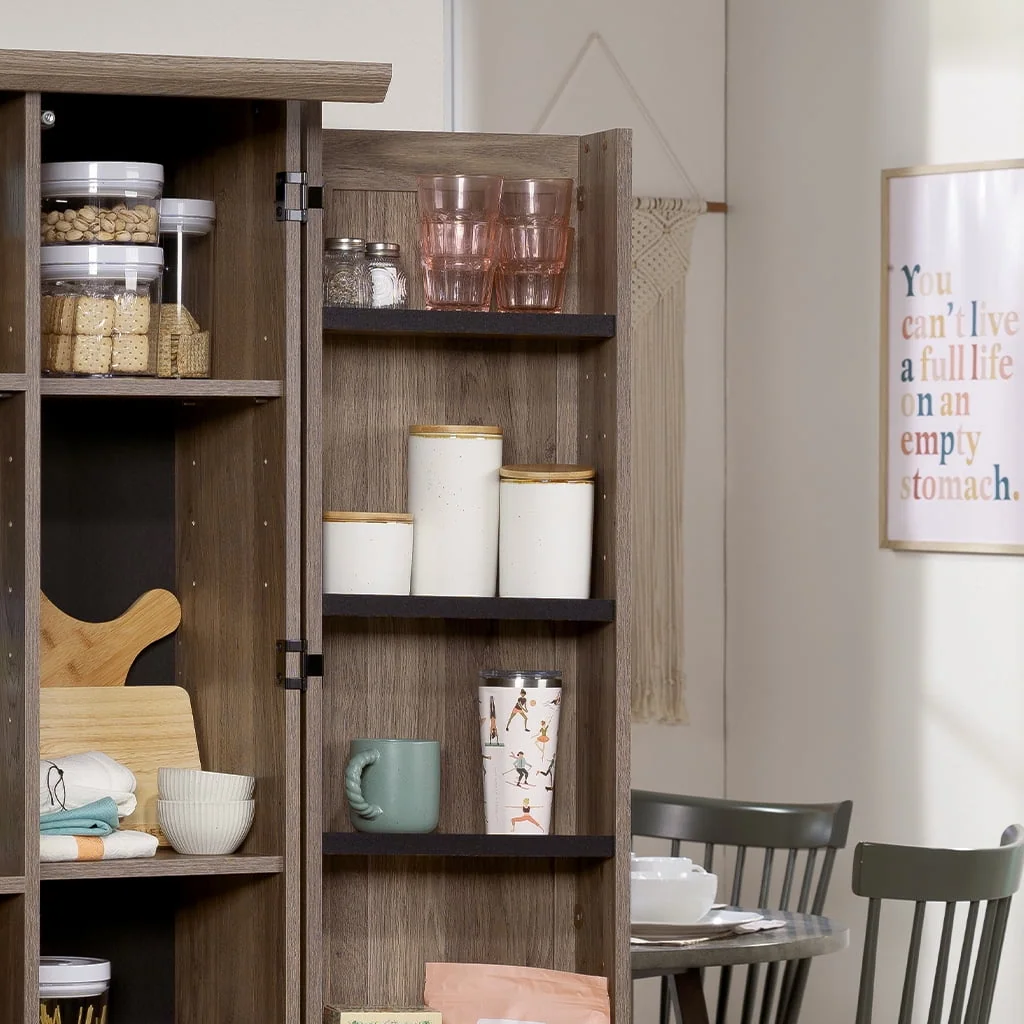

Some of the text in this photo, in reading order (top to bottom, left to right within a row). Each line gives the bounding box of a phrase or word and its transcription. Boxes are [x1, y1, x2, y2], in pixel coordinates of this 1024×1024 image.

[900, 263, 953, 298] You
[902, 299, 1021, 341] can't live
[900, 342, 1014, 383] a full life
[900, 390, 971, 418] on an
[900, 428, 983, 466] empty
[900, 463, 1021, 502] stomach.
